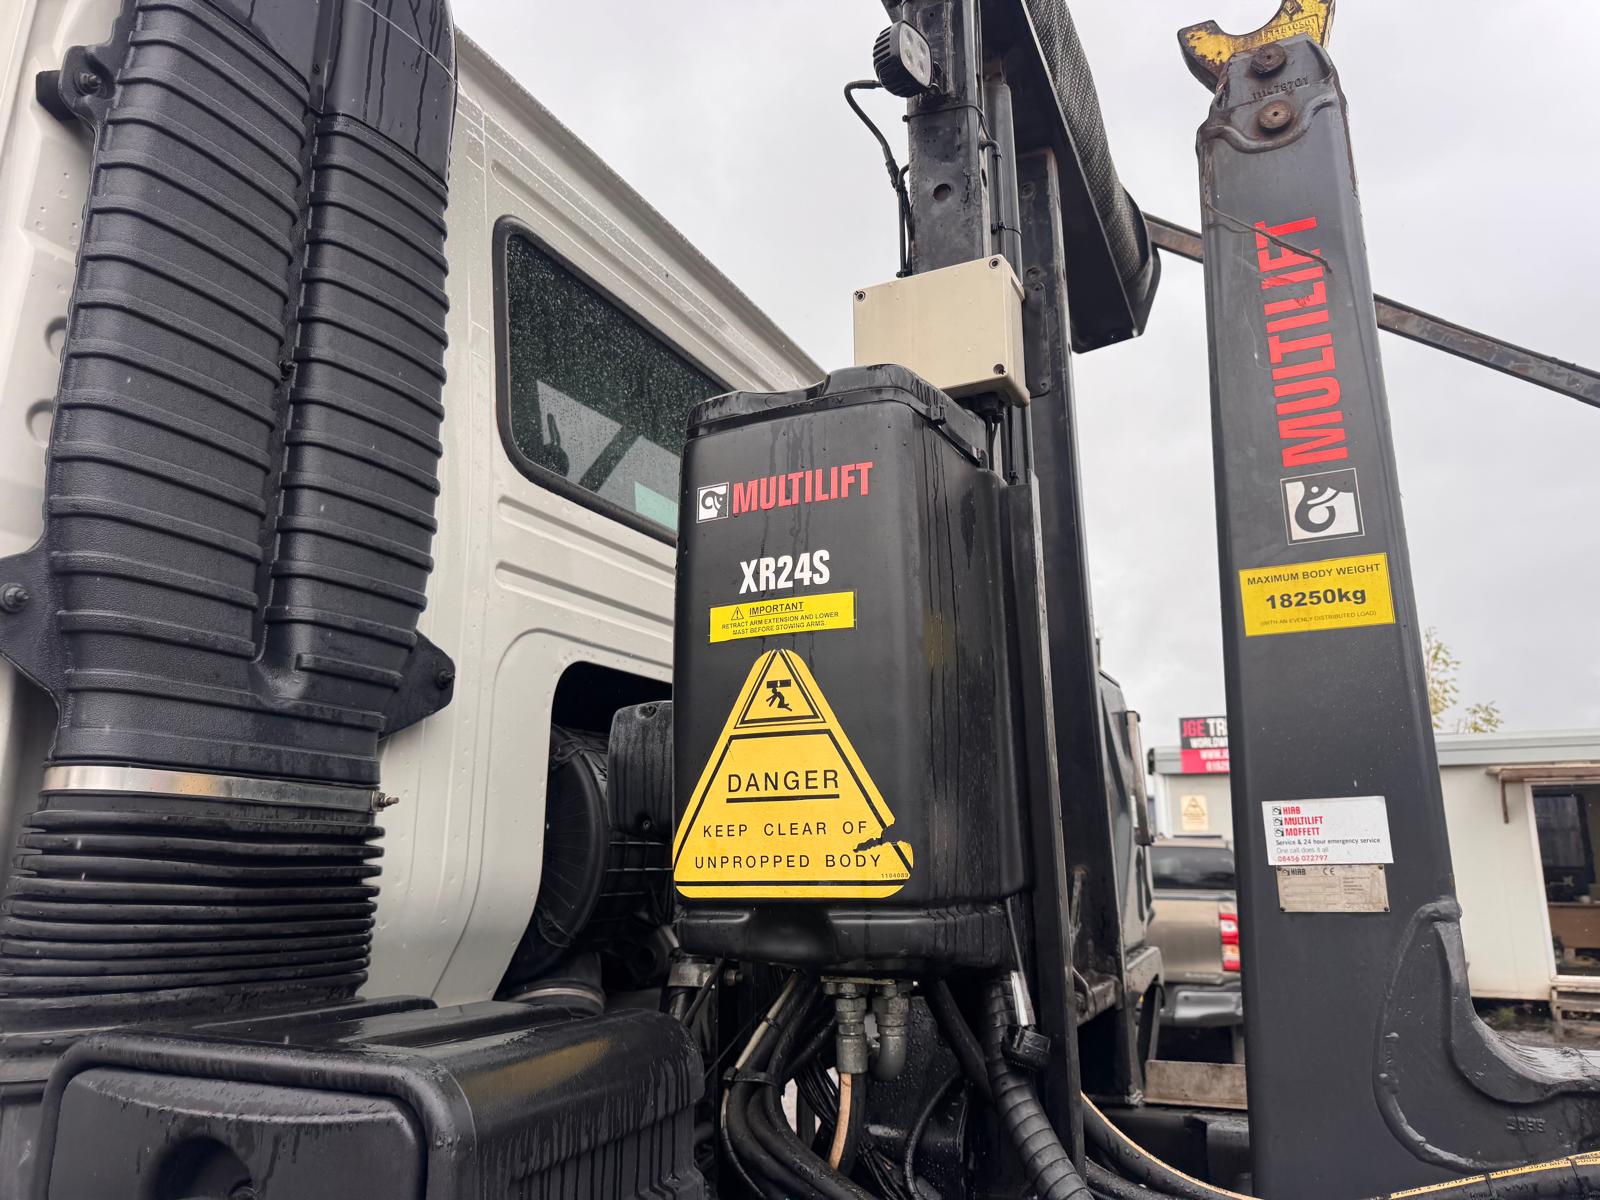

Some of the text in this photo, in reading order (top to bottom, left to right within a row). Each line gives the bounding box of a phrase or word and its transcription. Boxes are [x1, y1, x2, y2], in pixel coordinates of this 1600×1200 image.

[1255, 216, 1349, 468] MULTILIFT
[732, 461, 873, 515] MULTILIFT
[739, 550, 830, 594] XR24S
[1247, 563, 1380, 585] MAXIMUM BODY WEIGHT
[1266, 588, 1366, 609] 18250kg
[749, 602, 804, 615] IMPORTANT
[721, 621, 748, 630] RETRACT
[764, 615, 799, 624] EXTENSION
[800, 613, 814, 621] AND
[815, 611, 839, 619] LOWER
[1314, 612, 1356, 622] DISTRIBUTED
[732, 628, 749, 636] MAST
[750, 626, 775, 634] BEFORE
[775, 622, 805, 631] STOWING
[728, 769, 839, 793] DANGER
[1283, 806, 1301, 814] HIAB
[1284, 816, 1323, 825] MULTILIFT
[703, 821, 867, 837] KEEP CLEAR OF
[1286, 827, 1320, 836] MOFFETT
[695, 854, 881, 869] UNPROPPED BODY
